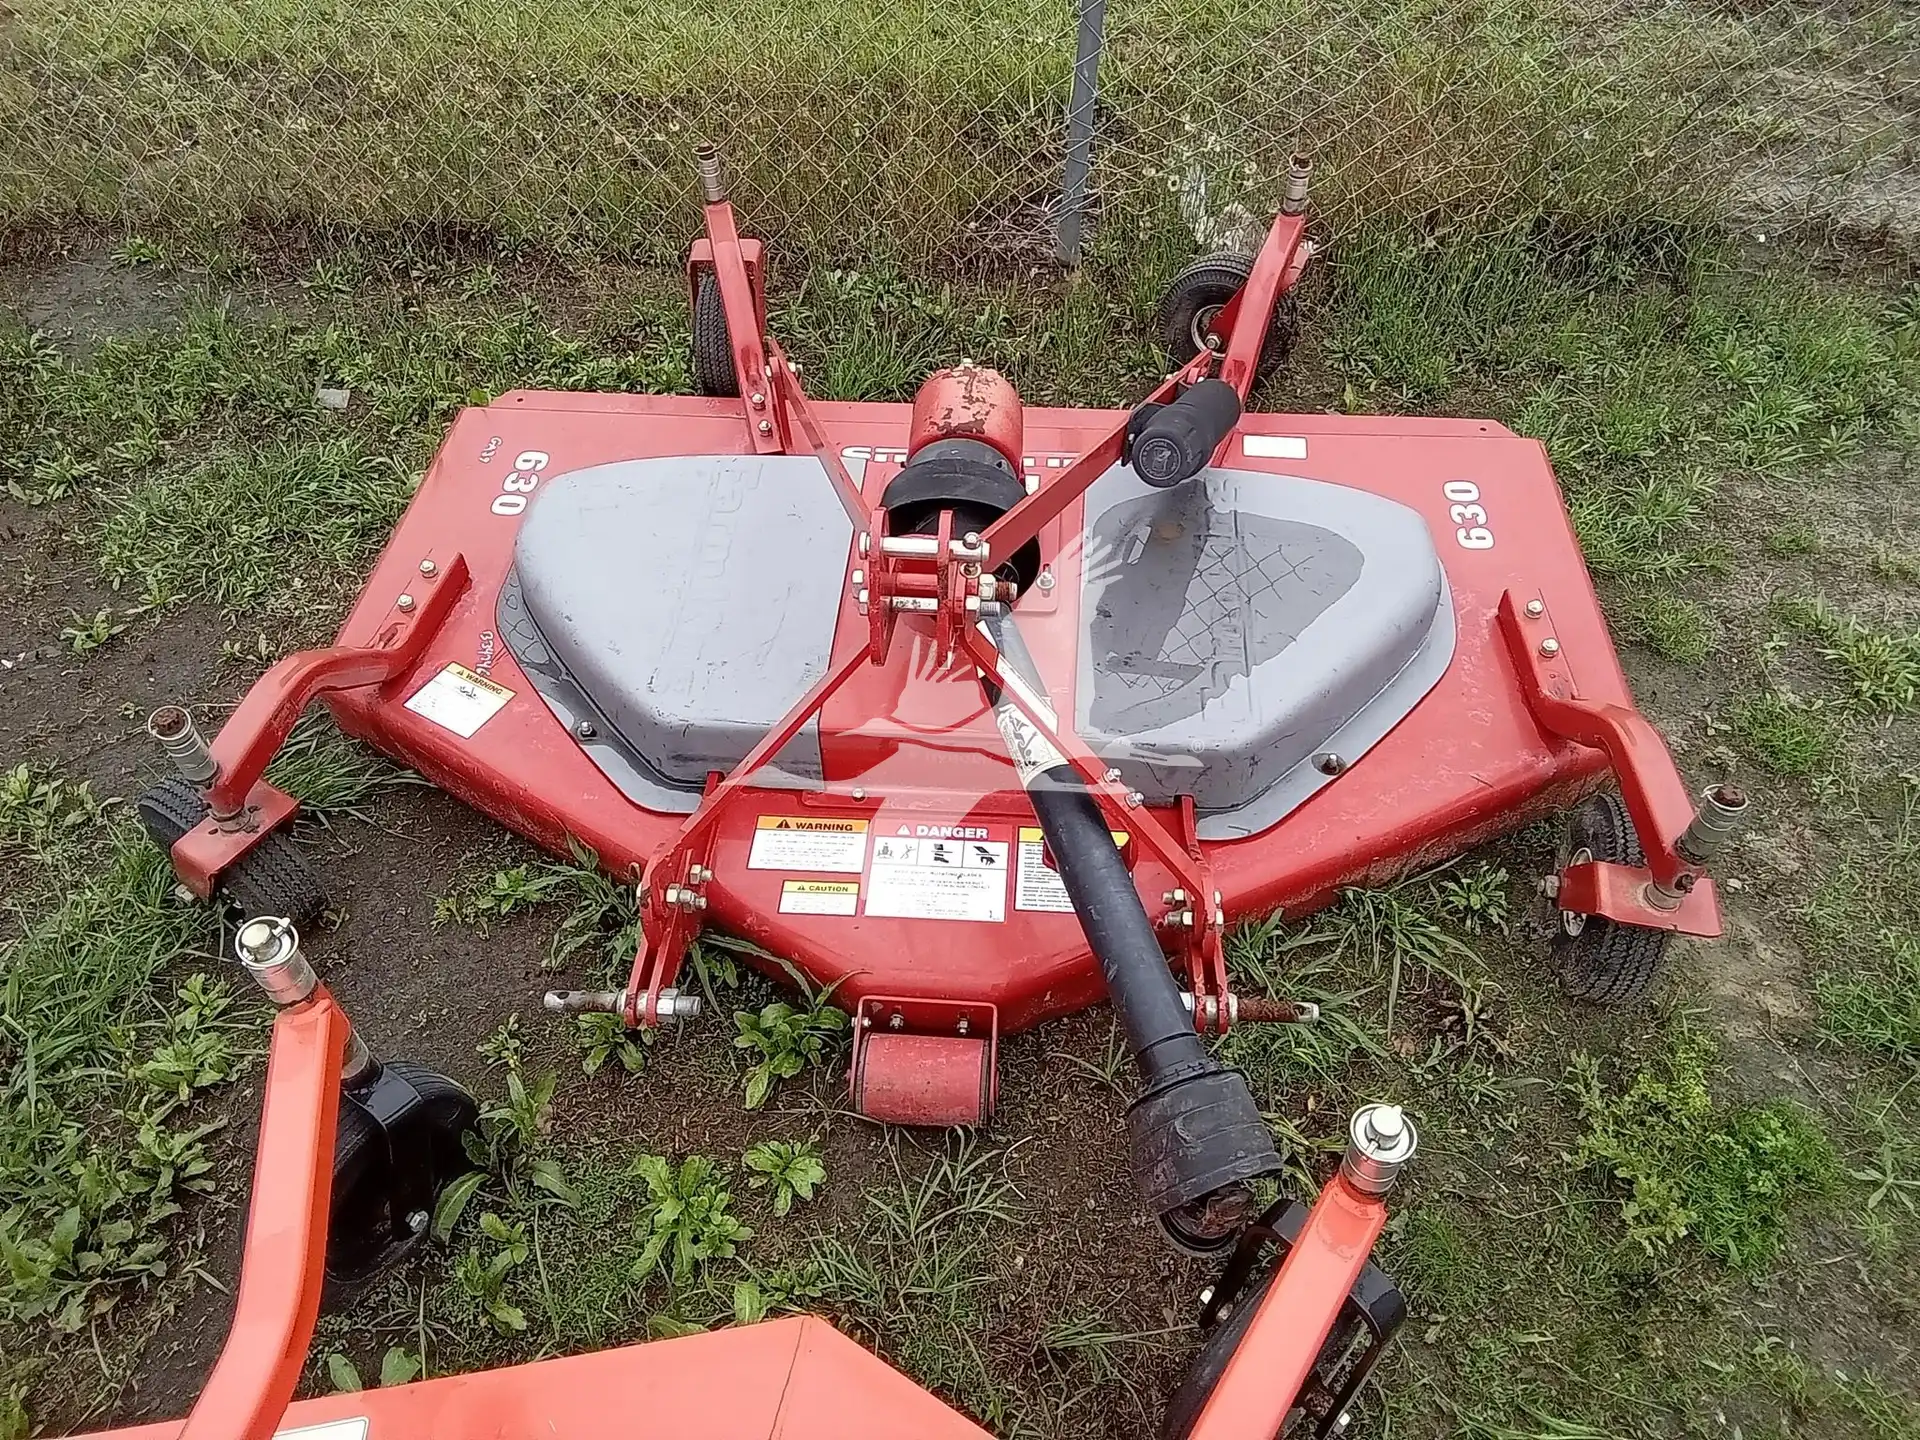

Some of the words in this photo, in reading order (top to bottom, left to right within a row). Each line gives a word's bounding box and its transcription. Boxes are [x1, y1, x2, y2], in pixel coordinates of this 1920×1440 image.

[490, 450, 550, 516] 630
[1442, 480, 1495, 550] 630
[465, 671, 504, 696] WARNING
[795, 821, 854, 832] WARNING
[915, 825, 989, 840] DANGER
[808, 884, 849, 893] CAUTION
